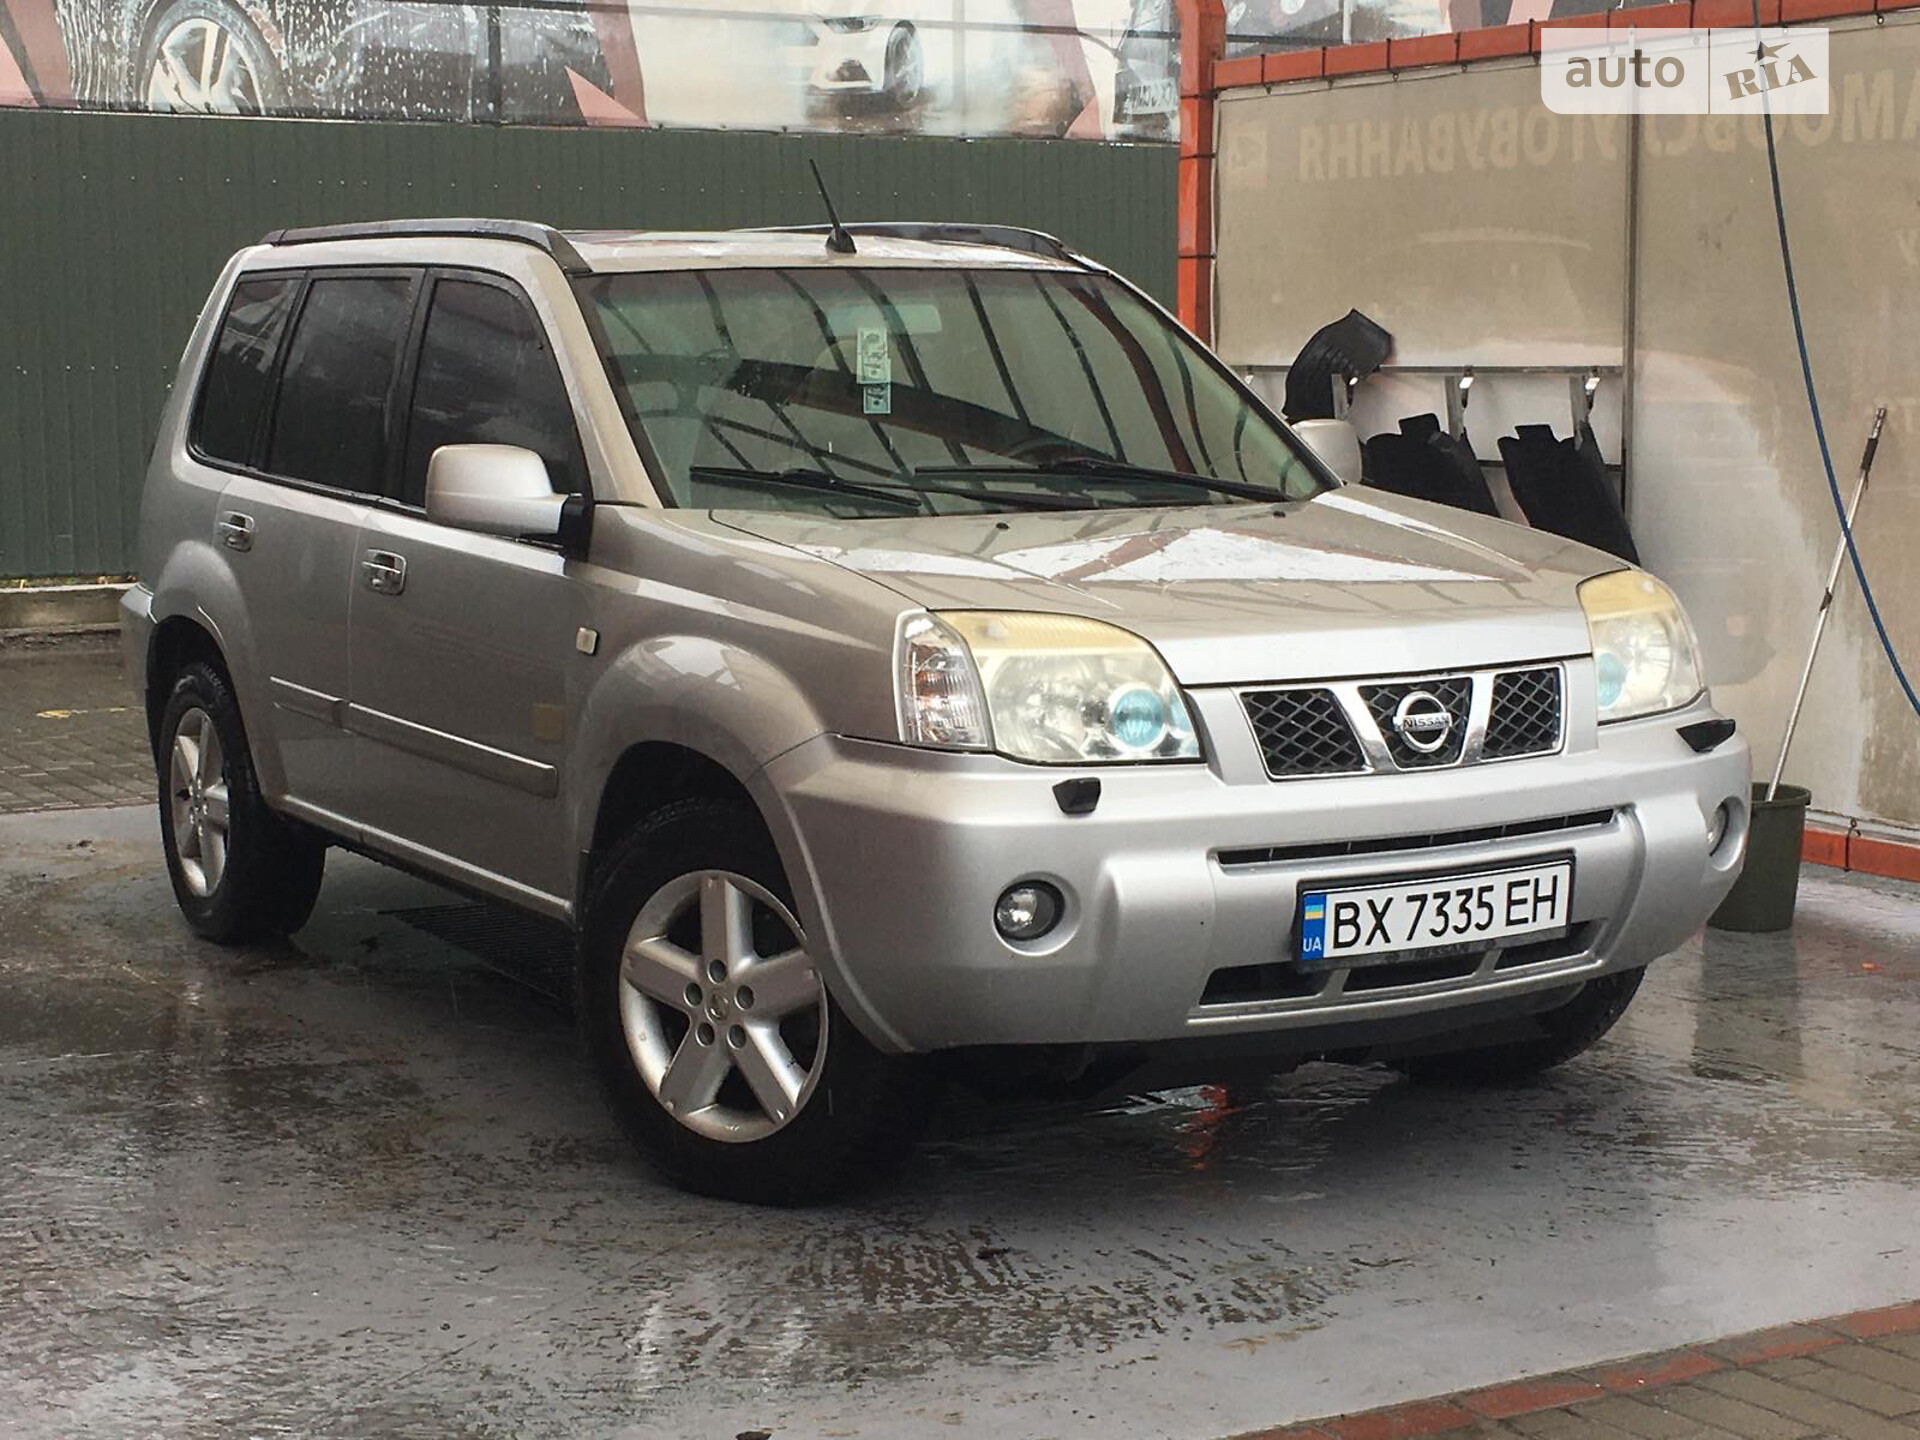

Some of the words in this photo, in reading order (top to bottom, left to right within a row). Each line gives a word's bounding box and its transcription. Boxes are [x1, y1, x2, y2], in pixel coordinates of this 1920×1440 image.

[1403, 714, 1451, 729] NISSAN
[1333, 897, 1394, 949] BX
[1406, 885, 1495, 941] 7335
[1505, 875, 1558, 927] EH
[1303, 937, 1322, 952] UA
